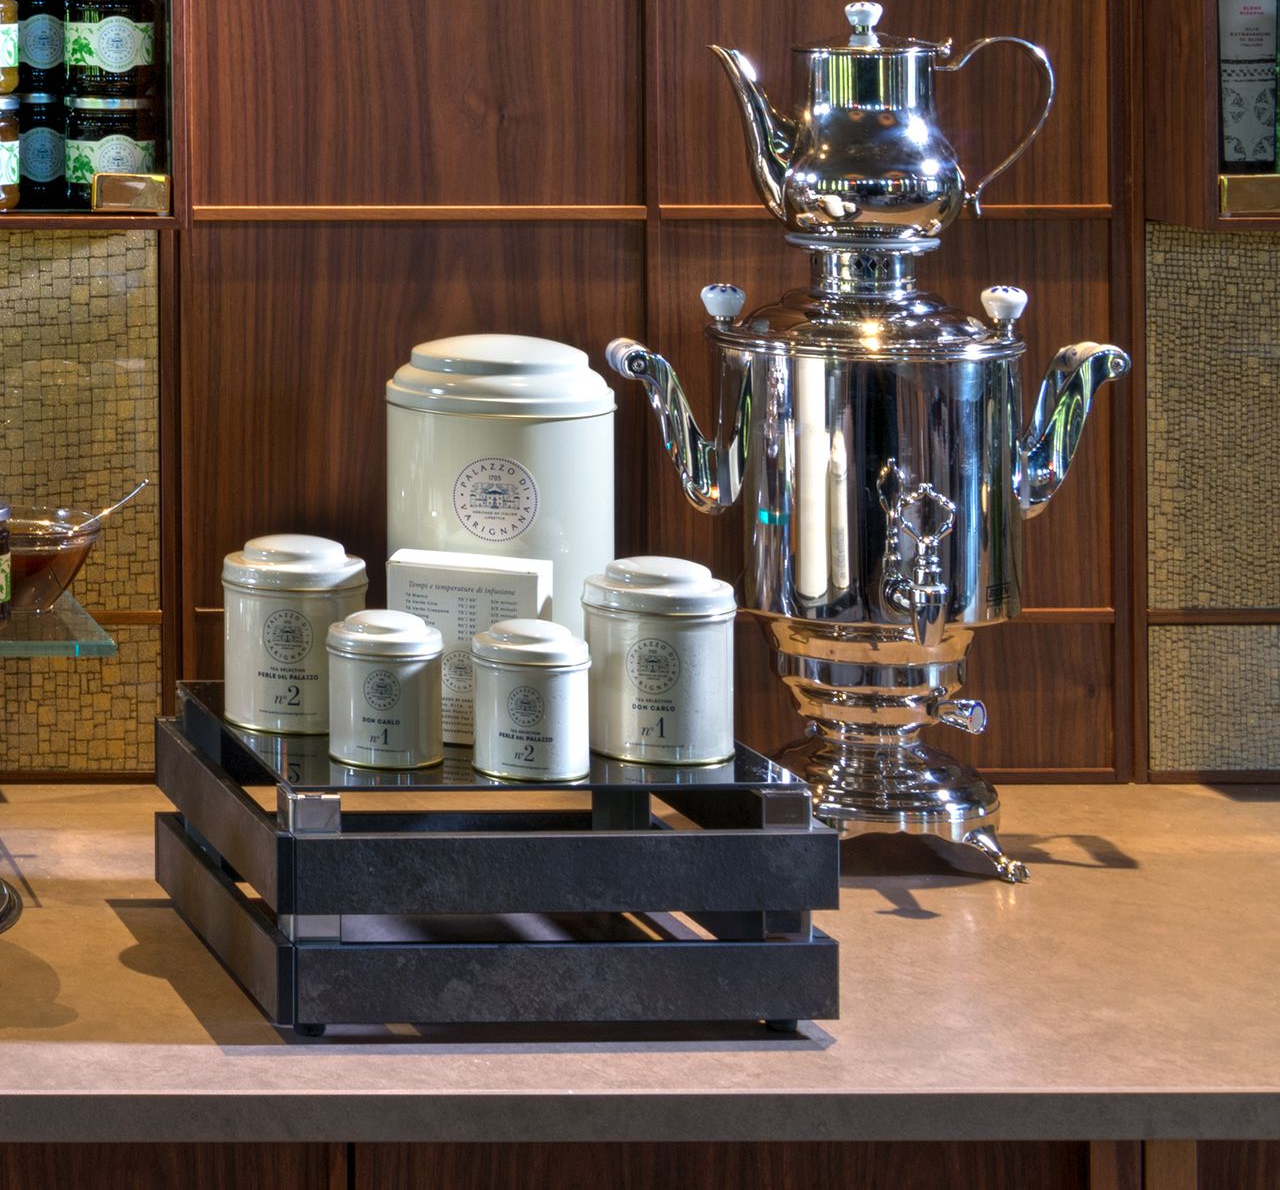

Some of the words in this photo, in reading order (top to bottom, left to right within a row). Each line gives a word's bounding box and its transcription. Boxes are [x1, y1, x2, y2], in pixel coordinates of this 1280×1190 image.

[460, 463, 515, 488] PALAZZO
[519, 478, 530, 491] DI
[460, 504, 530, 536] VARIGNANA
[408, 581, 428, 590] Tempi
[435, 584, 474, 593] temperature
[484, 587, 516, 596] infusione
[258, 671, 276, 679] PERLE
[525, 735, 553, 743] PALAZZO
